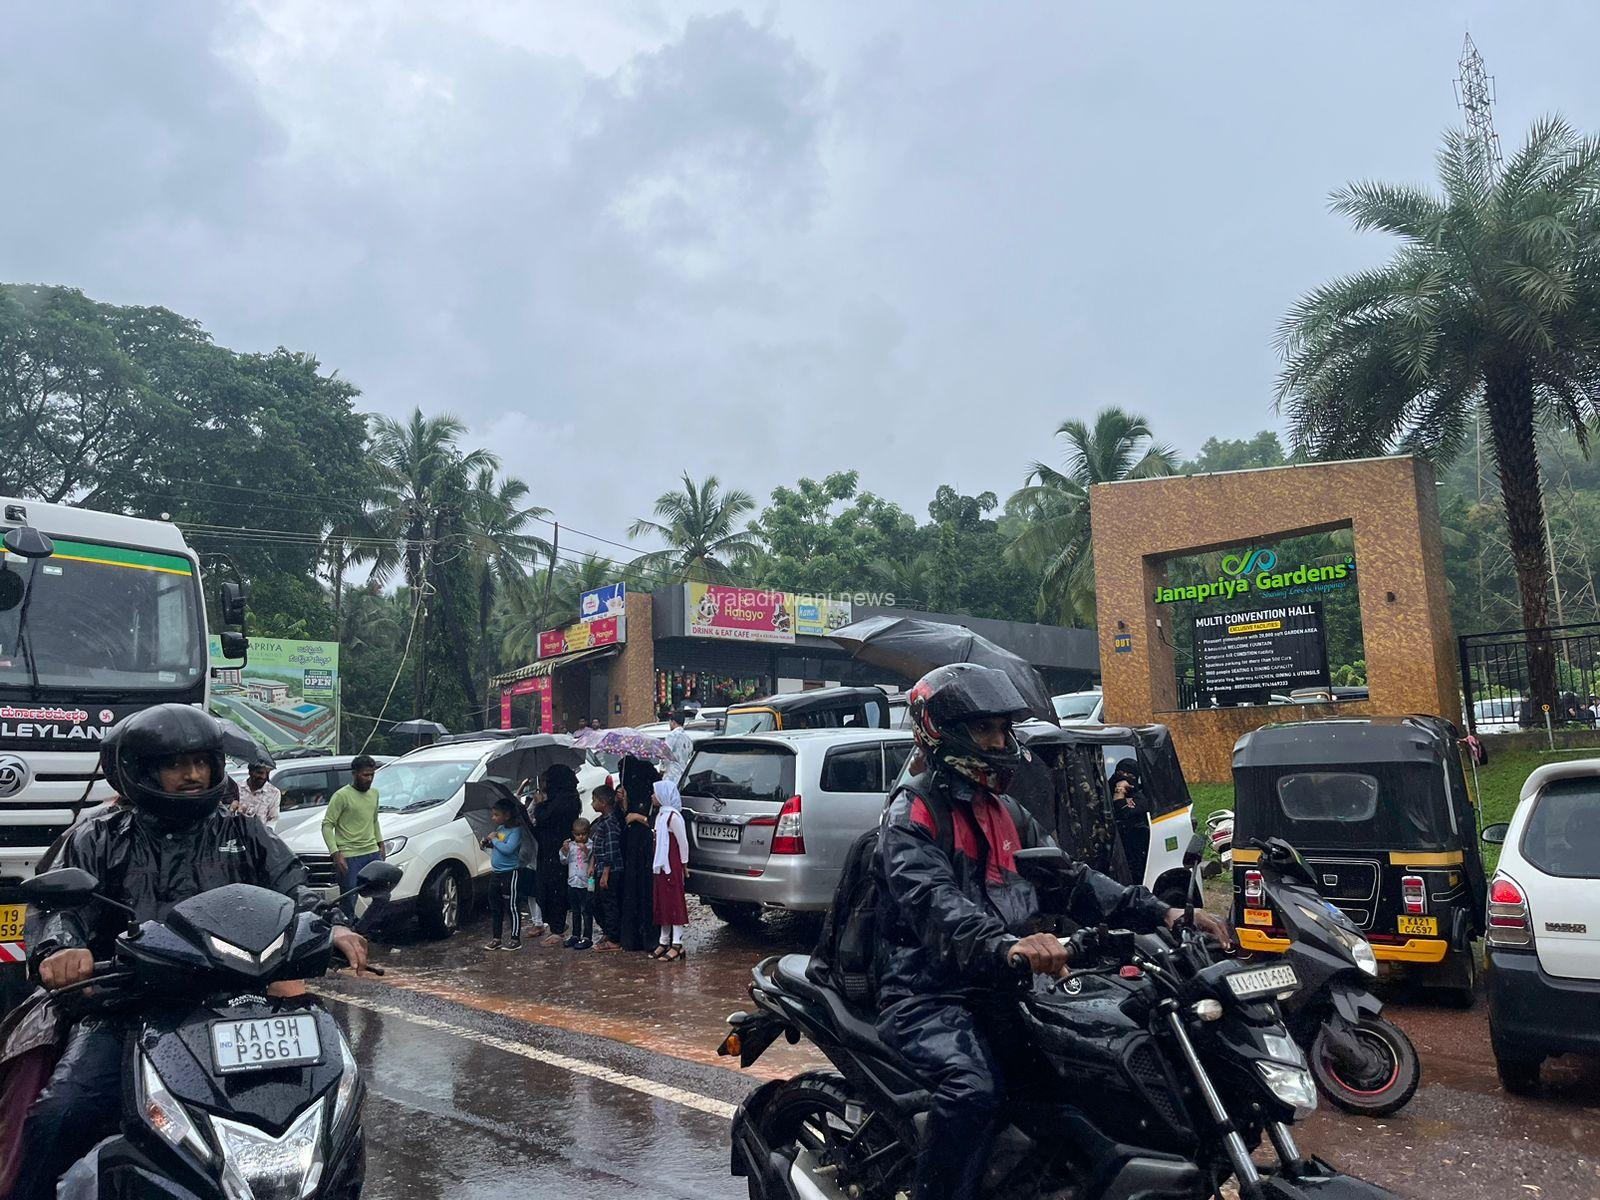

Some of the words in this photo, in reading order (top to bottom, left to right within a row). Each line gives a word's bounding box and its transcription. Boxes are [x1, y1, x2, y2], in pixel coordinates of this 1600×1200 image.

[1155, 576, 1250, 603] Janapriya
[1255, 564, 1347, 590] Gardens
[724, 605, 764, 621] Hangyo
[1196, 615, 1223, 627] MULTI
[1224, 608, 1286, 624] CONVENTION
[1288, 604, 1316, 617] HALL
[692, 626, 714, 636] DRINK
[720, 629, 733, 637] EAT
[733, 630, 750, 639] CAFE
[1229, 624, 1253, 632] EXCLUSIVE
[1284, 628, 1304, 636] GARDEN
[1115, 638, 1130, 648] OUT
[1249, 640, 1273, 648] FOUNTAIN
[1233, 650, 1258, 658] CONDITION
[1296, 669, 1320, 677] UTENSILS
[305, 678, 331, 686] OPEN
[234, 1018, 300, 1043] KA19H
[236, 1039, 302, 1063] P3661
